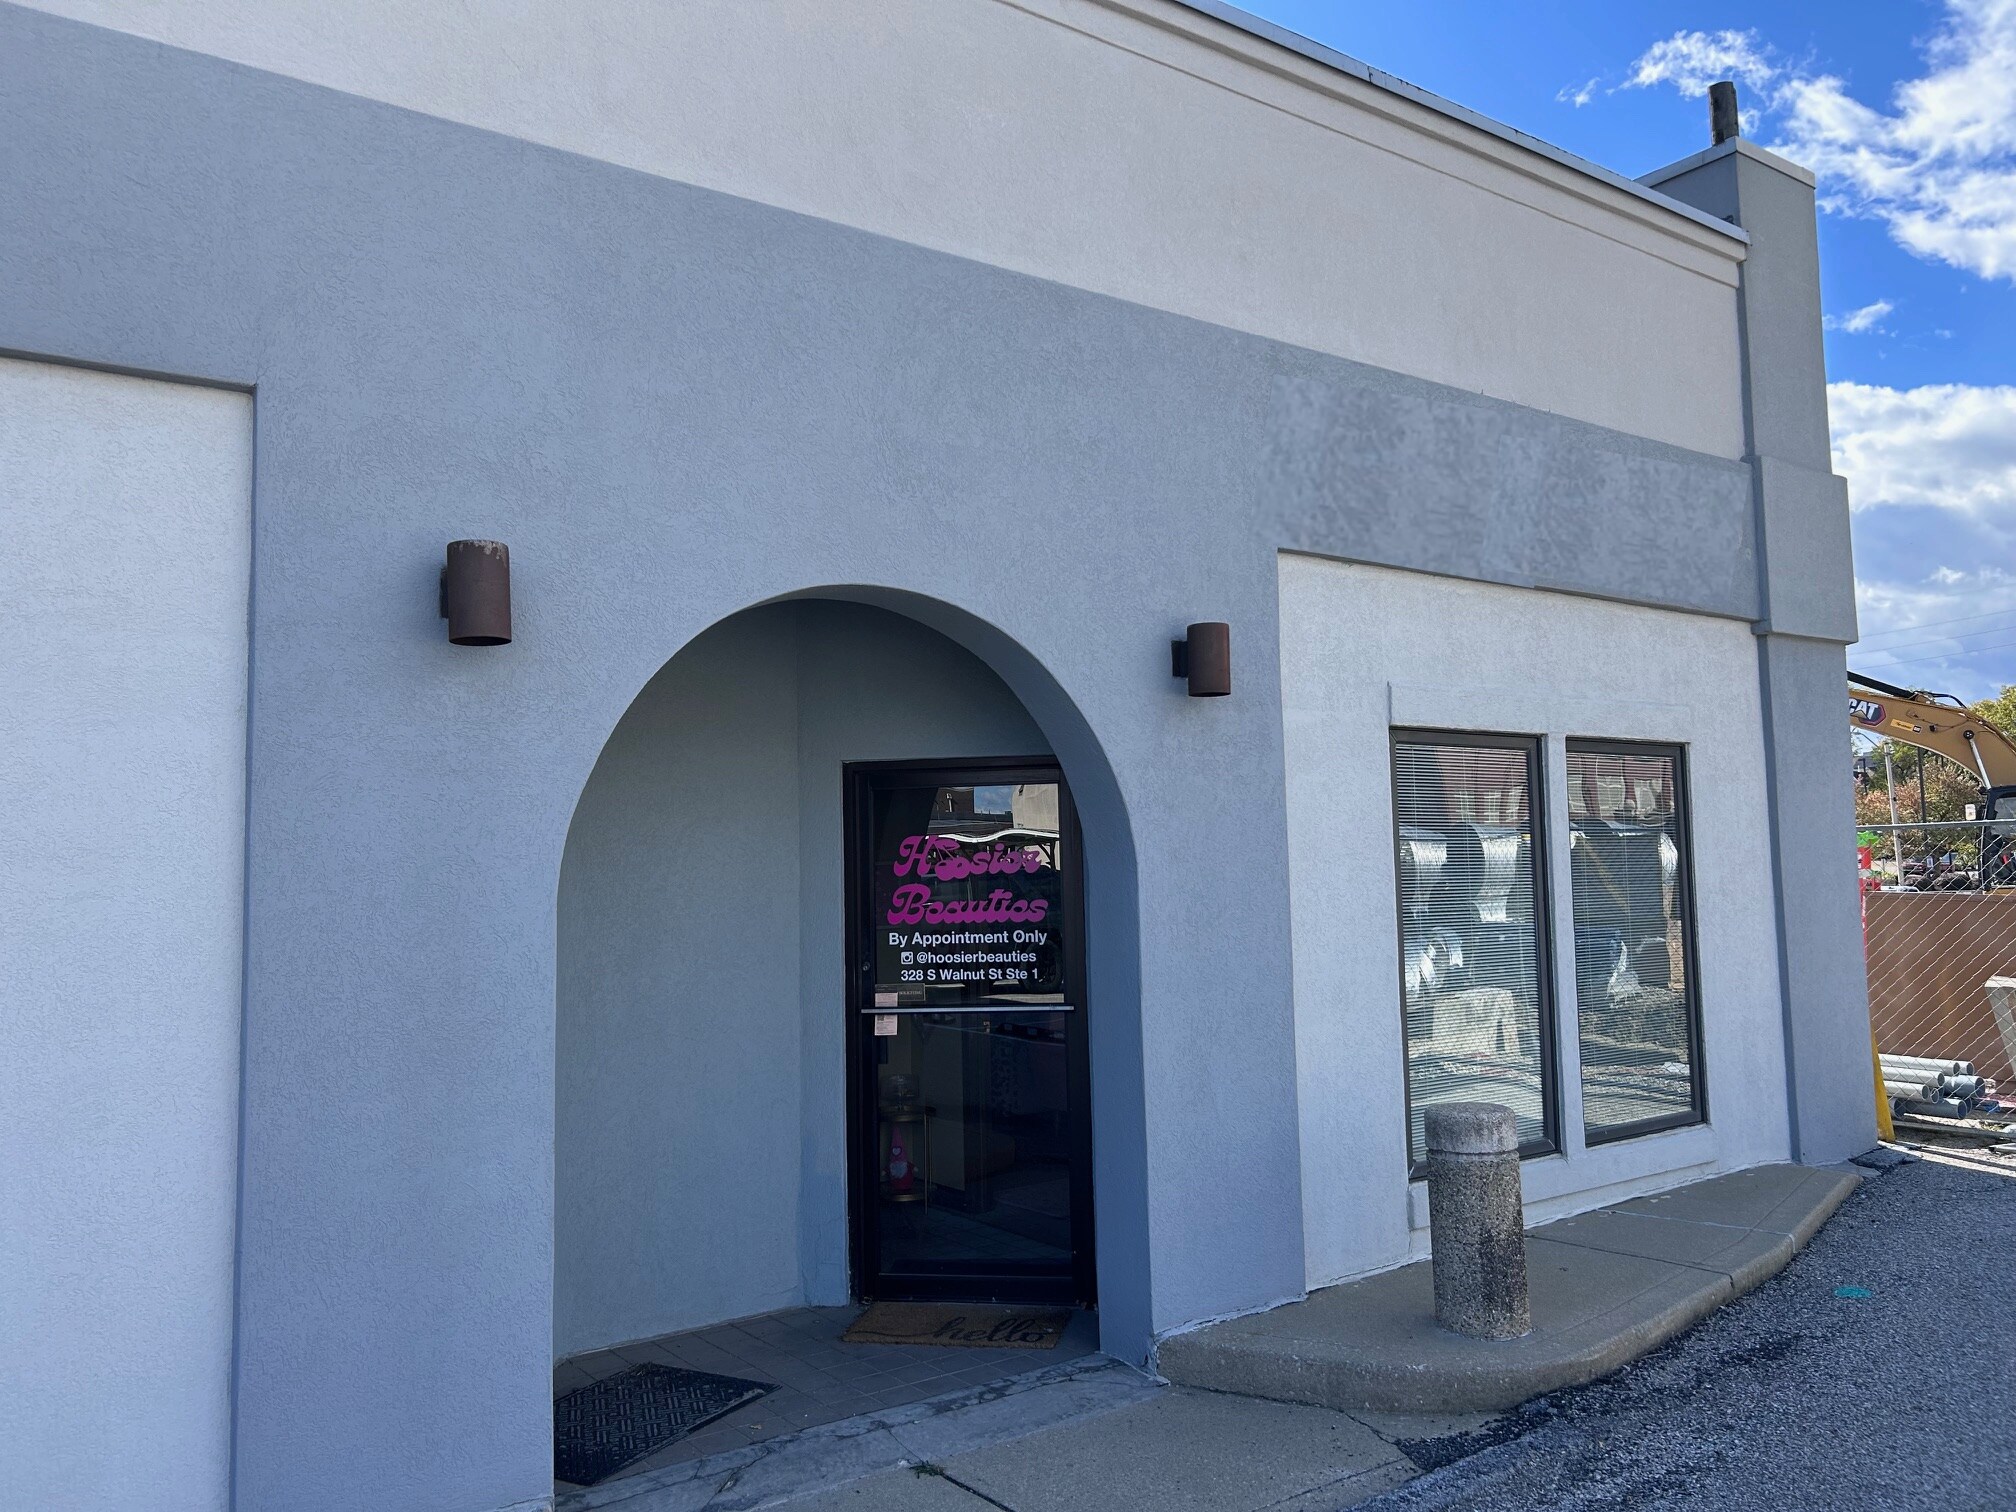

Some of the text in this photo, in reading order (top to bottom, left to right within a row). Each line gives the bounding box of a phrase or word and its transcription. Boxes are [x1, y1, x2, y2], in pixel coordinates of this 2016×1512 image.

[1849, 699, 1879, 720] CAT
[893, 835, 1042, 881] Hoosier
[887, 884, 1048, 925] Beauties
[888, 930, 1047, 947] By Appointment Only
[916, 950, 1037, 964] @hoosierbeauties
[900, 968, 1038, 981] 328 S Walnut St Ste 1
[933, 1316, 1046, 1344] hello
